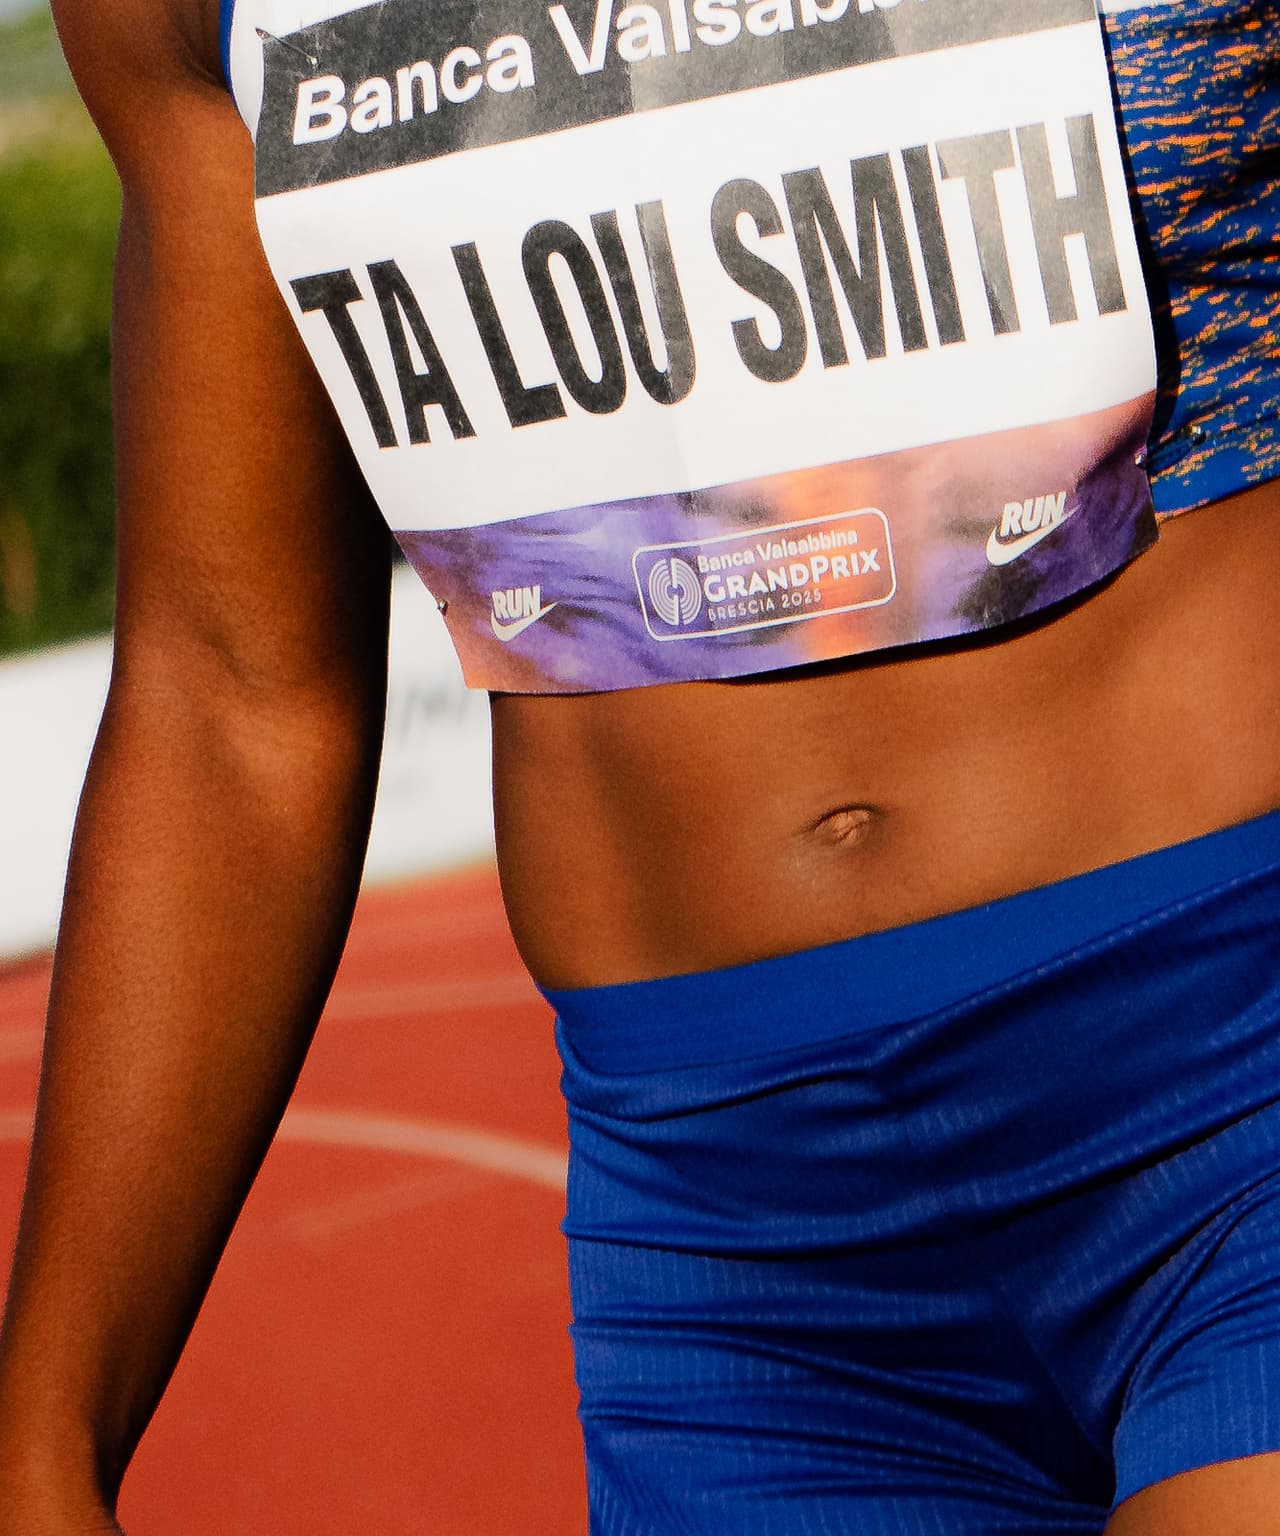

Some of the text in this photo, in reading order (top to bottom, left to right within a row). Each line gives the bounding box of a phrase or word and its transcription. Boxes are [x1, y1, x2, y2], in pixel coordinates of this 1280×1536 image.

[292, 32, 536, 145] Banca
[290, 113, 1128, 449] TA LOU SMITH
[1000, 491, 1066, 537] RUN
[697, 529, 858, 573] Banca Valsabbina
[492, 585, 540, 619] RUN
[707, 589, 822, 622] BRESCIA 2025
